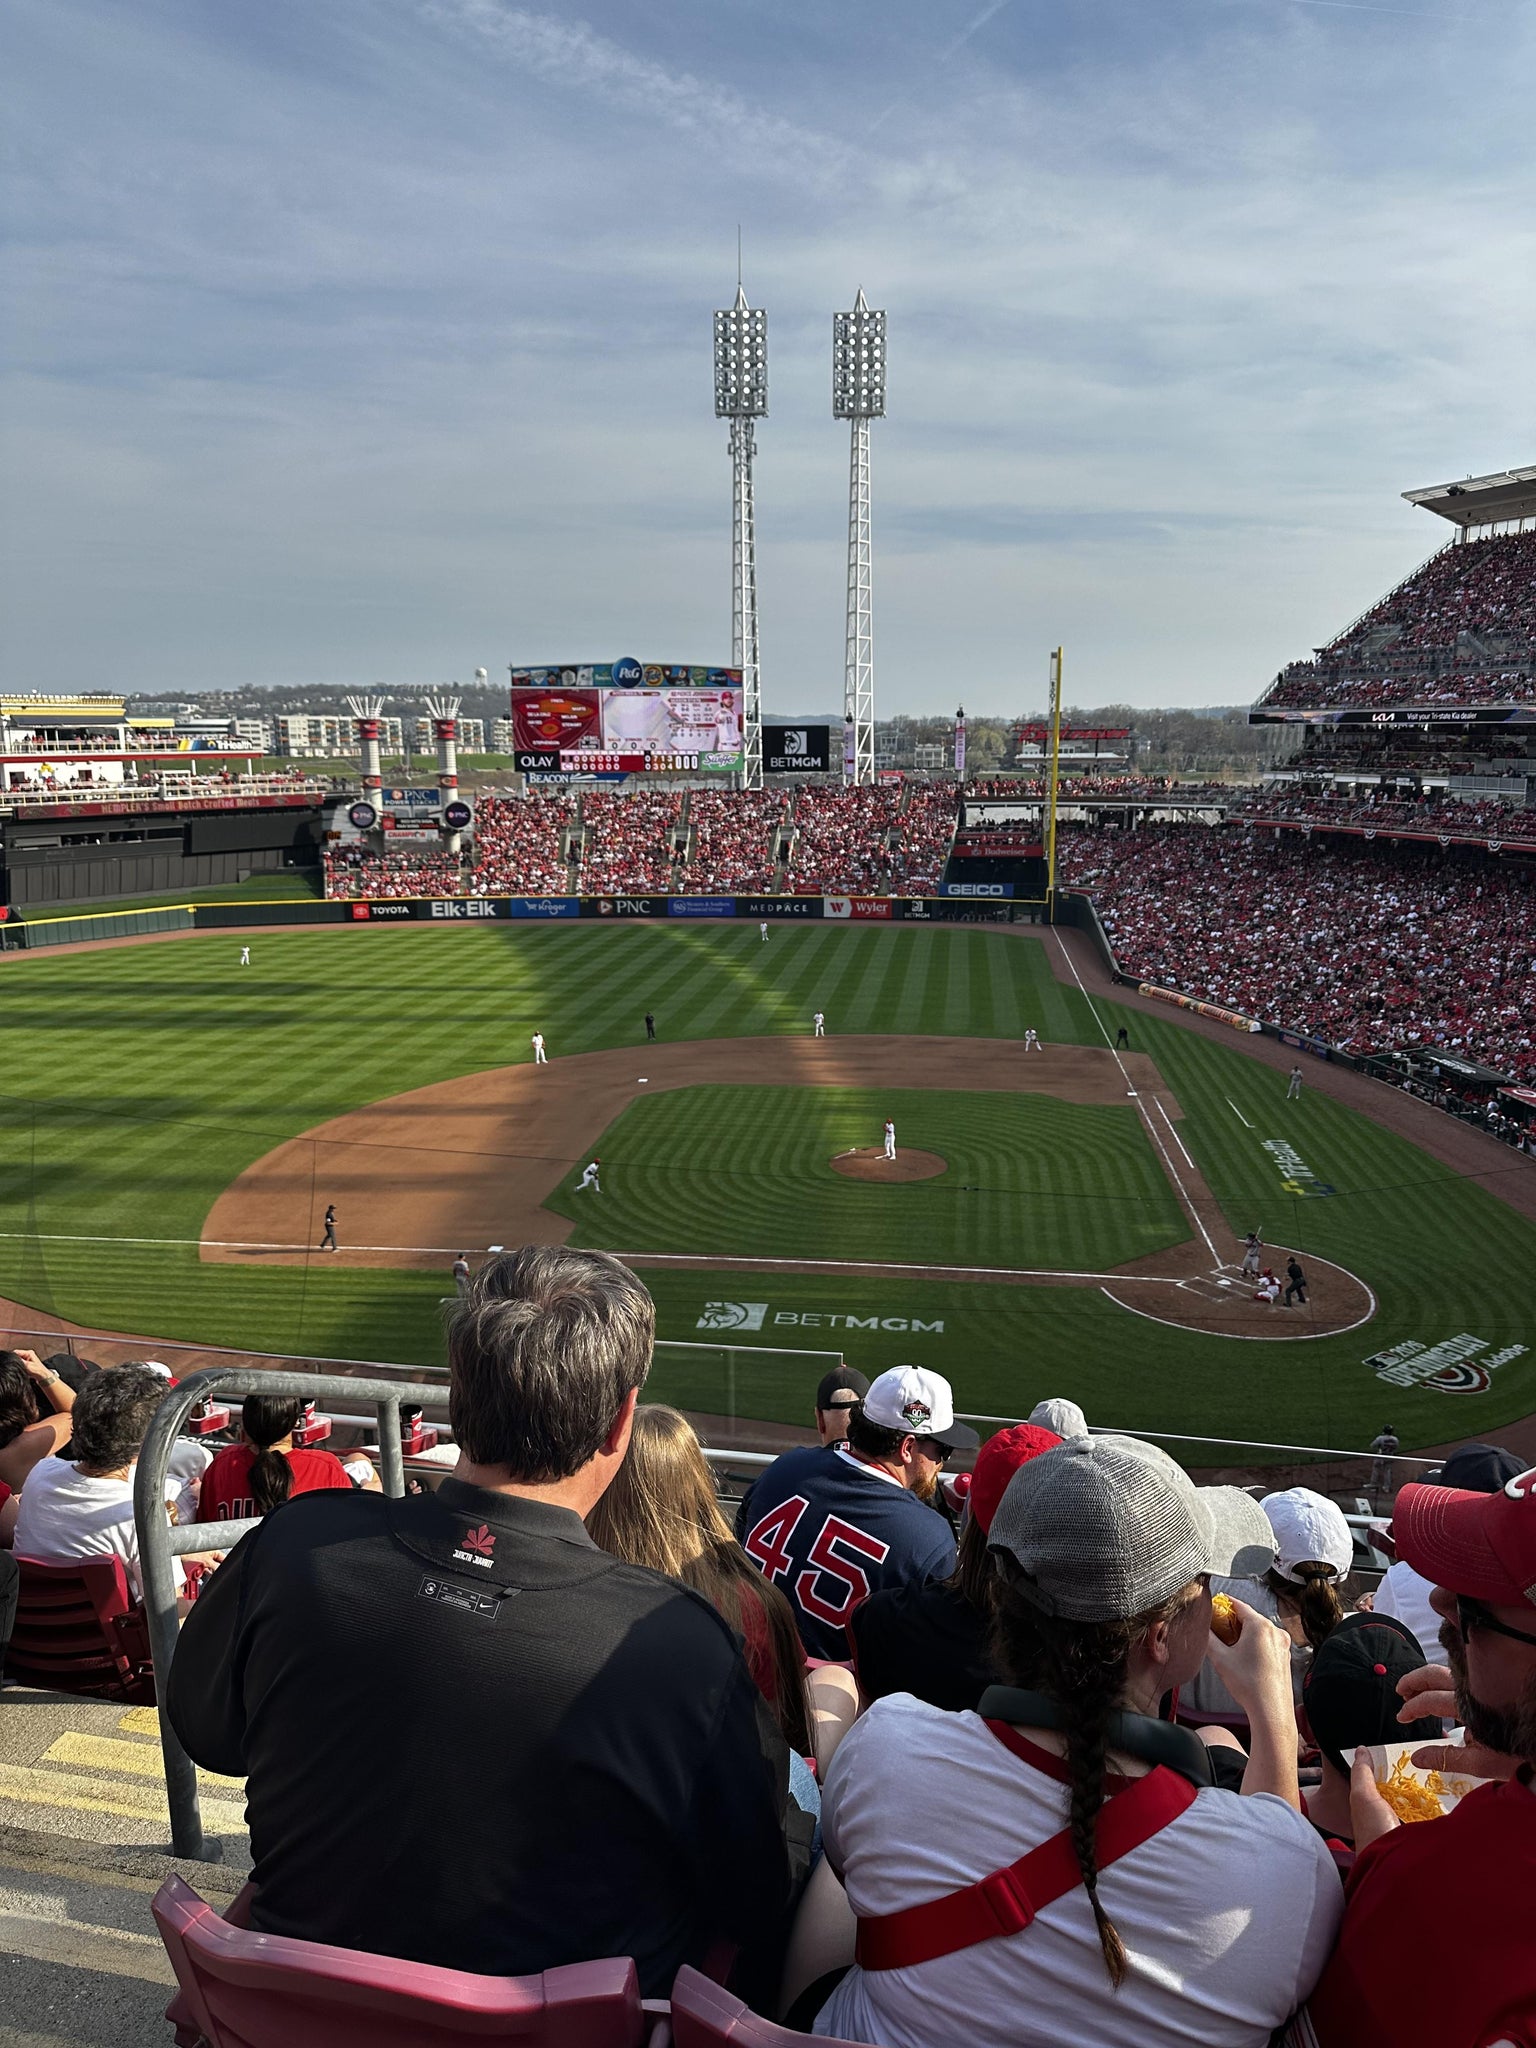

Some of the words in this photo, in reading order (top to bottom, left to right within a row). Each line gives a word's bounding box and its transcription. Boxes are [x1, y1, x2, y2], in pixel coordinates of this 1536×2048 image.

[619, 667, 640, 678] P&G
[1460, 712, 1478, 720] dealer
[216, 740, 252, 750] TriHealth
[520, 756, 554, 767] OLAY
[770, 756, 821, 767] BETMGM
[530, 772, 569, 784] BEACON
[404, 790, 430, 800] PNC
[204, 798, 234, 809] Crafted
[984, 848, 1026, 856] Budweiser
[948, 884, 1004, 896] GEICO
[372, 906, 410, 914] TOYOTA
[538, 900, 566, 915] Kroger
[616, 900, 650, 914] PNC
[750, 904, 808, 912] MEDPACE
[856, 902, 888, 914] Wyler
[774, 1312, 944, 1333] BETMGM
[1376, 1346, 1457, 1387] OPENING
[1437, 1332, 1490, 1360] DAY
[1480, 1344, 1530, 1368] Adobe
[744, 1494, 890, 1630] 45
